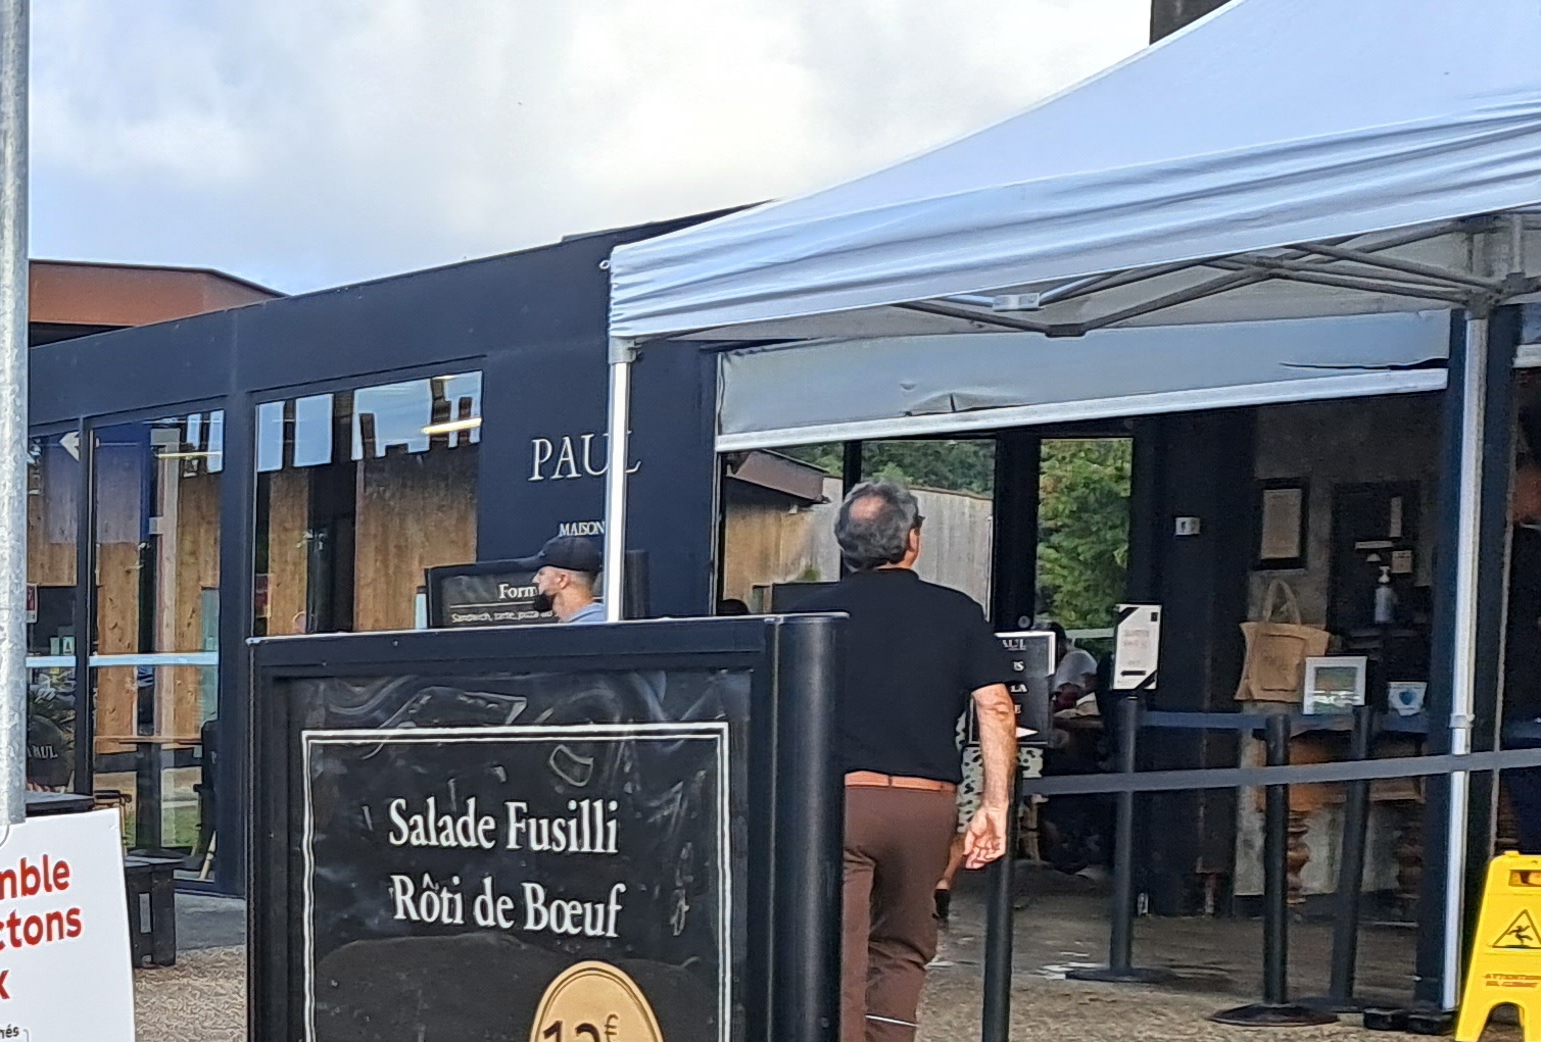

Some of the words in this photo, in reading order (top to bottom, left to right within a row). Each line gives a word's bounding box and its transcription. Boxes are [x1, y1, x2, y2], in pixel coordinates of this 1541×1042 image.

[559, 521, 606, 536] MAISON
[498, 584, 539, 599] Form
[389, 796, 496, 848] Salade
[505, 799, 619, 853] Fusilli
[391, 873, 465, 926] Rôti
[473, 877, 515, 929] de
[522, 882, 627, 938] Bœuf
